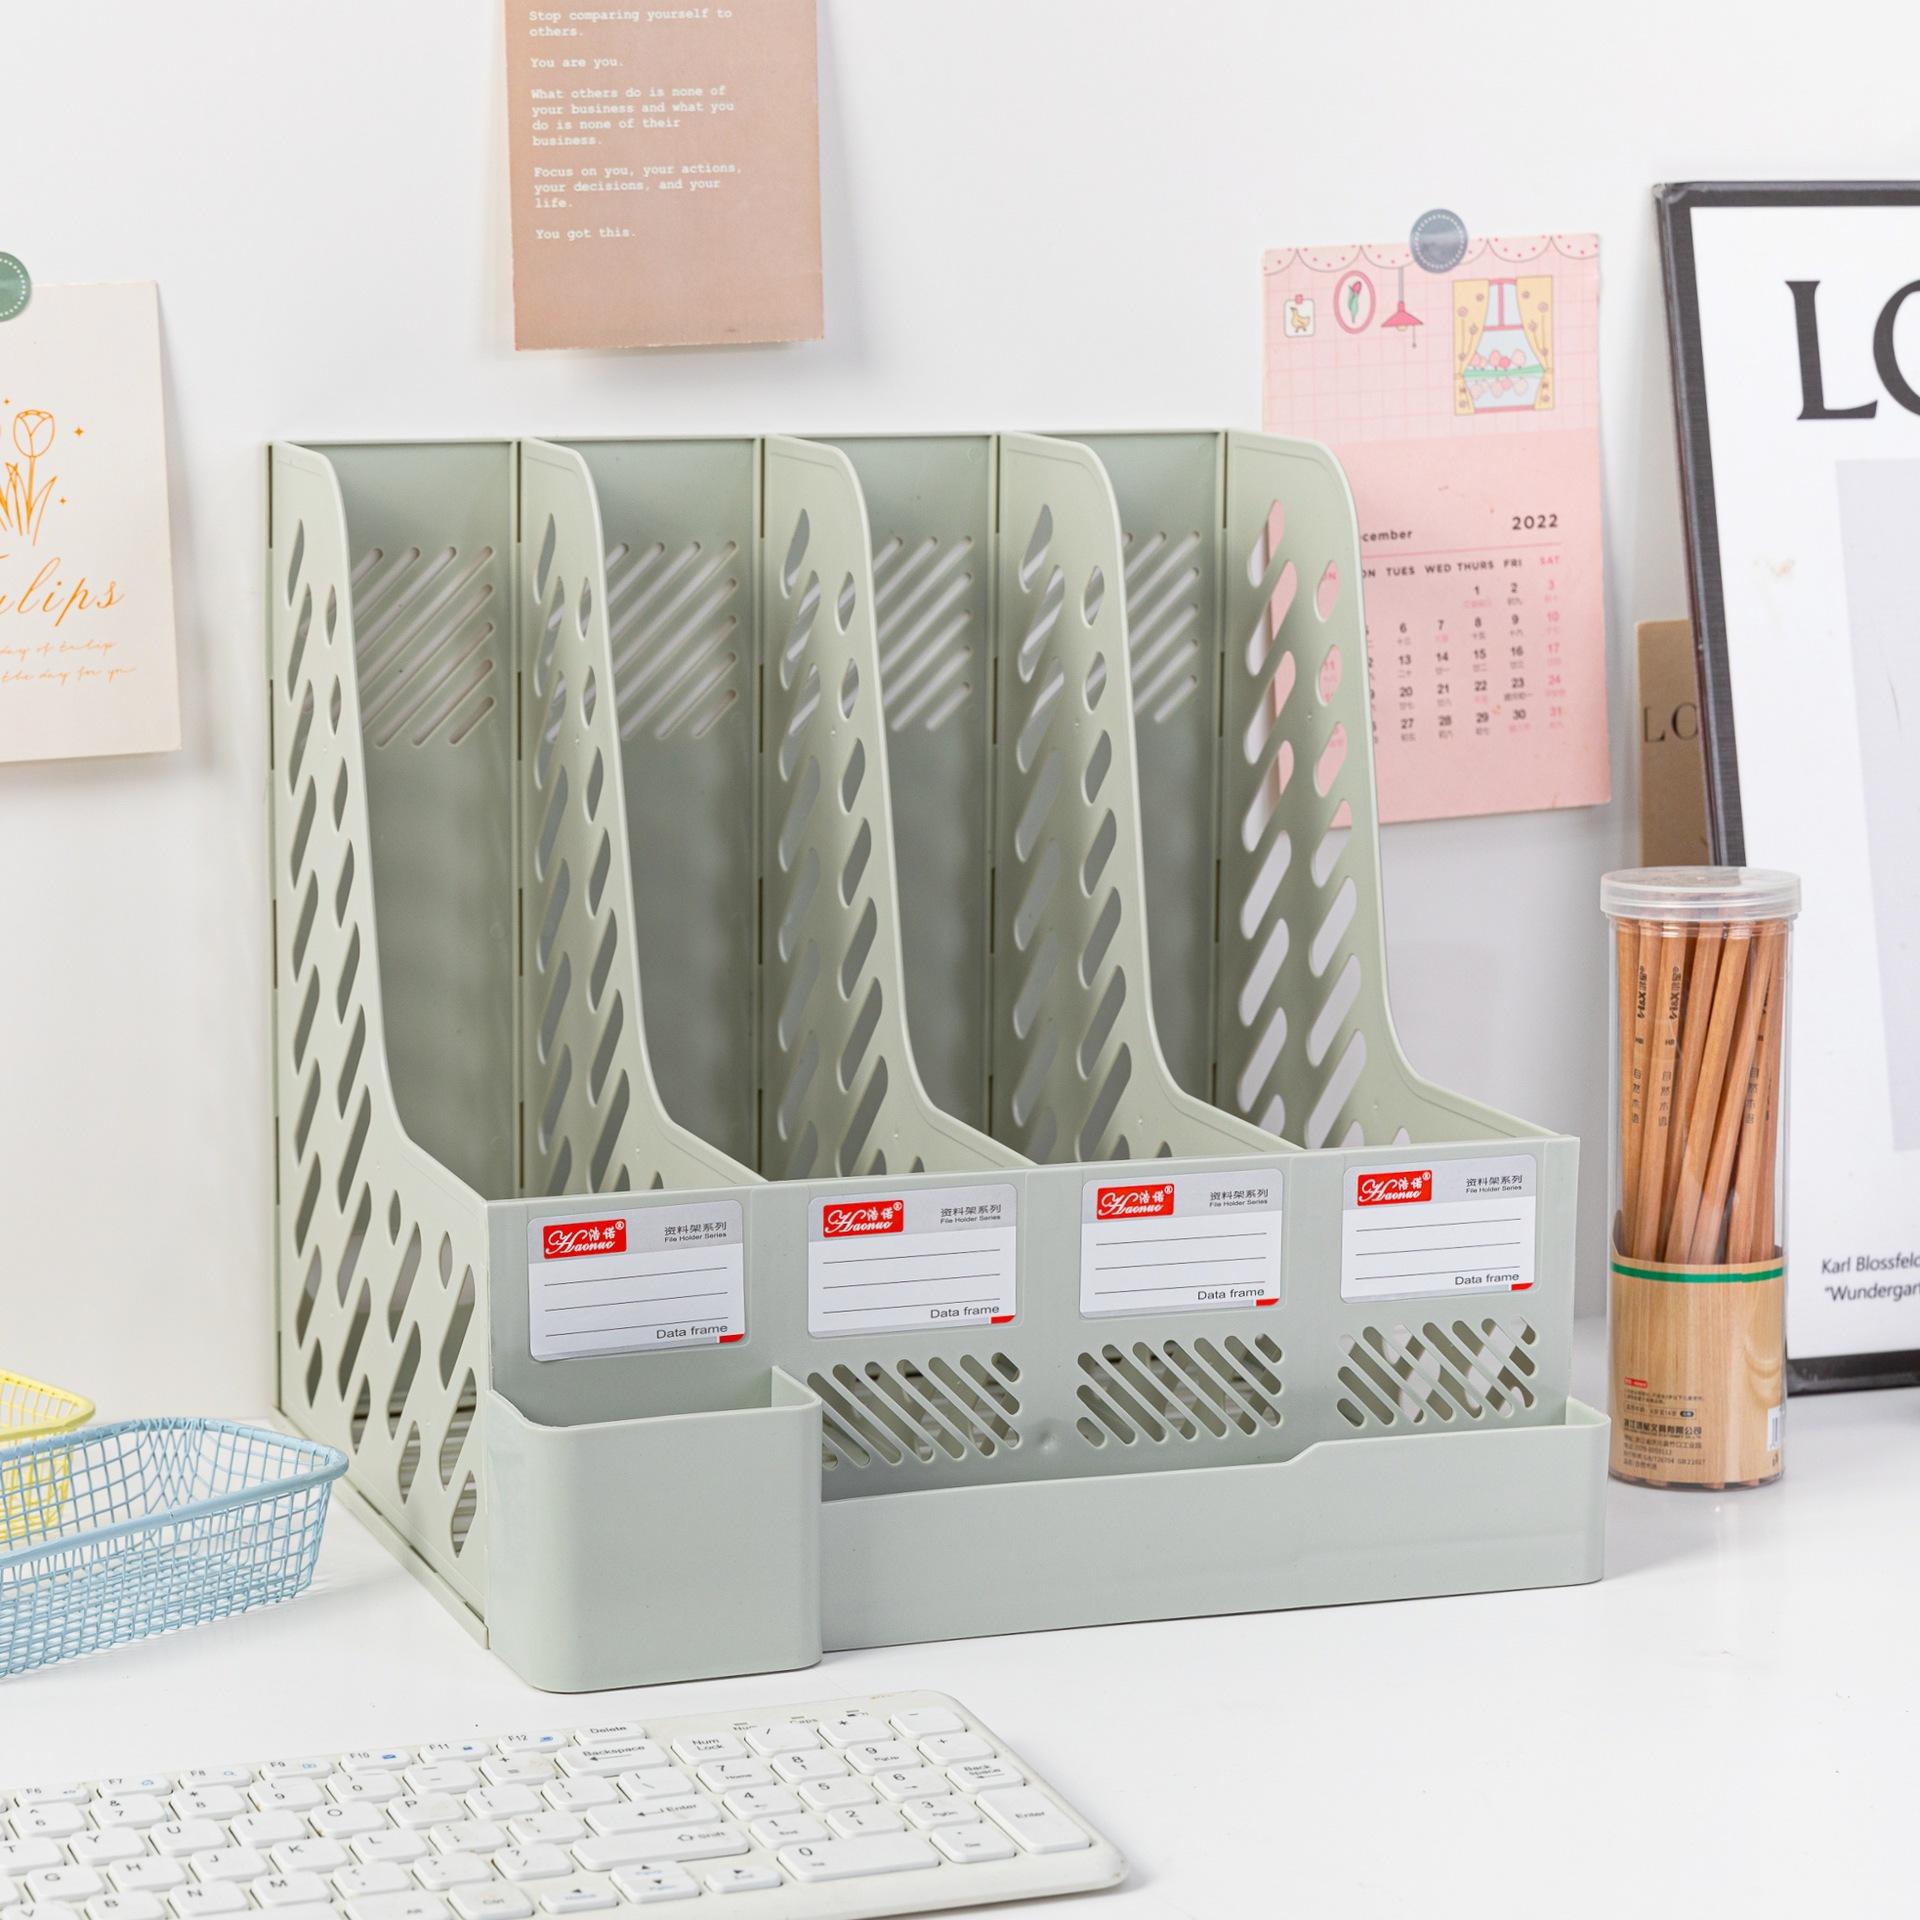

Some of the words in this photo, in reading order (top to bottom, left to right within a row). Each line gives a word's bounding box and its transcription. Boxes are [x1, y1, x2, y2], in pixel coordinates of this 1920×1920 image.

[529, 10, 561, 23] Stop
[569, 9, 640, 22] comparing
[647, 8, 708, 20] yourself
[717, 9, 732, 19] to
[529, 26, 584, 37] others.
[531, 58, 555, 68] You
[562, 58, 586, 67] are
[593, 58, 624, 70] you.
[531, 89, 563, 99] What
[571, 88, 618, 99] others
[625, 87, 641, 98] do
[649, 87, 664, 97] is
[672, 87, 703, 97] none
[710, 85, 727, 96] of
[532, 105, 564, 117] your
[571, 103, 634, 114] business
[642, 102, 666, 113] and
[672, 101, 704, 112] what
[710, 103, 735, 114] you
[532, 120, 548, 130] do
[556, 119, 572, 130] is
[579, 120, 611, 129] none
[618, 118, 635, 129] of
[643, 117, 681, 129] their
[532, 136, 603, 146] business.
[534, 167, 574, 178] Focus
[581, 167, 597, 177] on
[604, 167, 635, 179] you,
[643, 166, 675, 177] your
[682, 163, 742, 175] actions,
[534, 183, 566, 196] your
[573, 181, 651, 192] decisions,
[658, 179, 683, 190] and
[690, 179, 721, 192] your
[535, 198, 573, 209] life.
[536, 229, 560, 240] You
[567, 229, 592, 242] got
[599, 228, 636, 238] this.
[1512, 514, 1558, 530] 2022
[1361, 529, 1413, 542] cember
[1386, 567, 1415, 576] TUES
[1425, 564, 1451, 574] WED
[1457, 561, 1494, 572] THURS
[1504, 559, 1522, 568] FRI
[1540, 556, 1560, 566] SAT
[1474, 586, 1480, 595] 1
[1511, 583, 1518, 593] 2
[1400, 623, 1407, 633] 6
[1438, 620, 1444, 630] 7
[1475, 618, 1481, 628] 8
[1512, 615, 1519, 625] 9
[1547, 612, 1559, 622] 10
[1399, 656, 1411, 665] 13
[1437, 652, 1448, 662] 14
[1474, 650, 1486, 660] 15
[1511, 647, 1523, 657] 16
[1548, 644, 1559, 654] 17
[1400, 687, 1413, 697] 20
[1437, 684, 1449, 694] 21
[1475, 681, 1487, 691] 22
[1512, 678, 1524, 688] 23
[1549, 675, 1561, 685] 24
[1401, 719, 1414, 728] 27
[1439, 716, 1451, 726] 28
[1477, 713, 1489, 723] 29
[1513, 710, 1526, 720] 30
[1550, 707, 1562, 717] 31
[1466, 1174, 1523, 1188] 资料架系列
[1210, 1189, 1269, 1201] 资料架系列
[1359, 1179, 1421, 1202] Haonuo
[940, 1204, 1001, 1218] 资料架系列
[1098, 1192, 1164, 1216] Haonuo
[825, 1209, 893, 1233] Haonuo
[664, 1221, 727, 1236] 资料架系列
[545, 1230, 615, 1254] Haonuo
[1821, 1256, 1851, 1274] Karl
[1455, 1274, 1482, 1286] Data
[1486, 1272, 1520, 1283] frame
[1198, 1290, 1226, 1301] Data
[1230, 1287, 1264, 1298] frame
[930, 1308, 960, 1319] Data
[963, 1305, 1000, 1317] frame
[656, 1327, 687, 1340] Data
[690, 1323, 728, 1336] frame
[508, 1734, 528, 1742] F12
[590, 1725, 627, 1734] Delete
[692, 1738, 719, 1746] Num
[583, 1744, 645, 1756] Backspace
[666, 1803, 697, 1813] Enter
[1015, 1810, 1045, 1819] Enter
